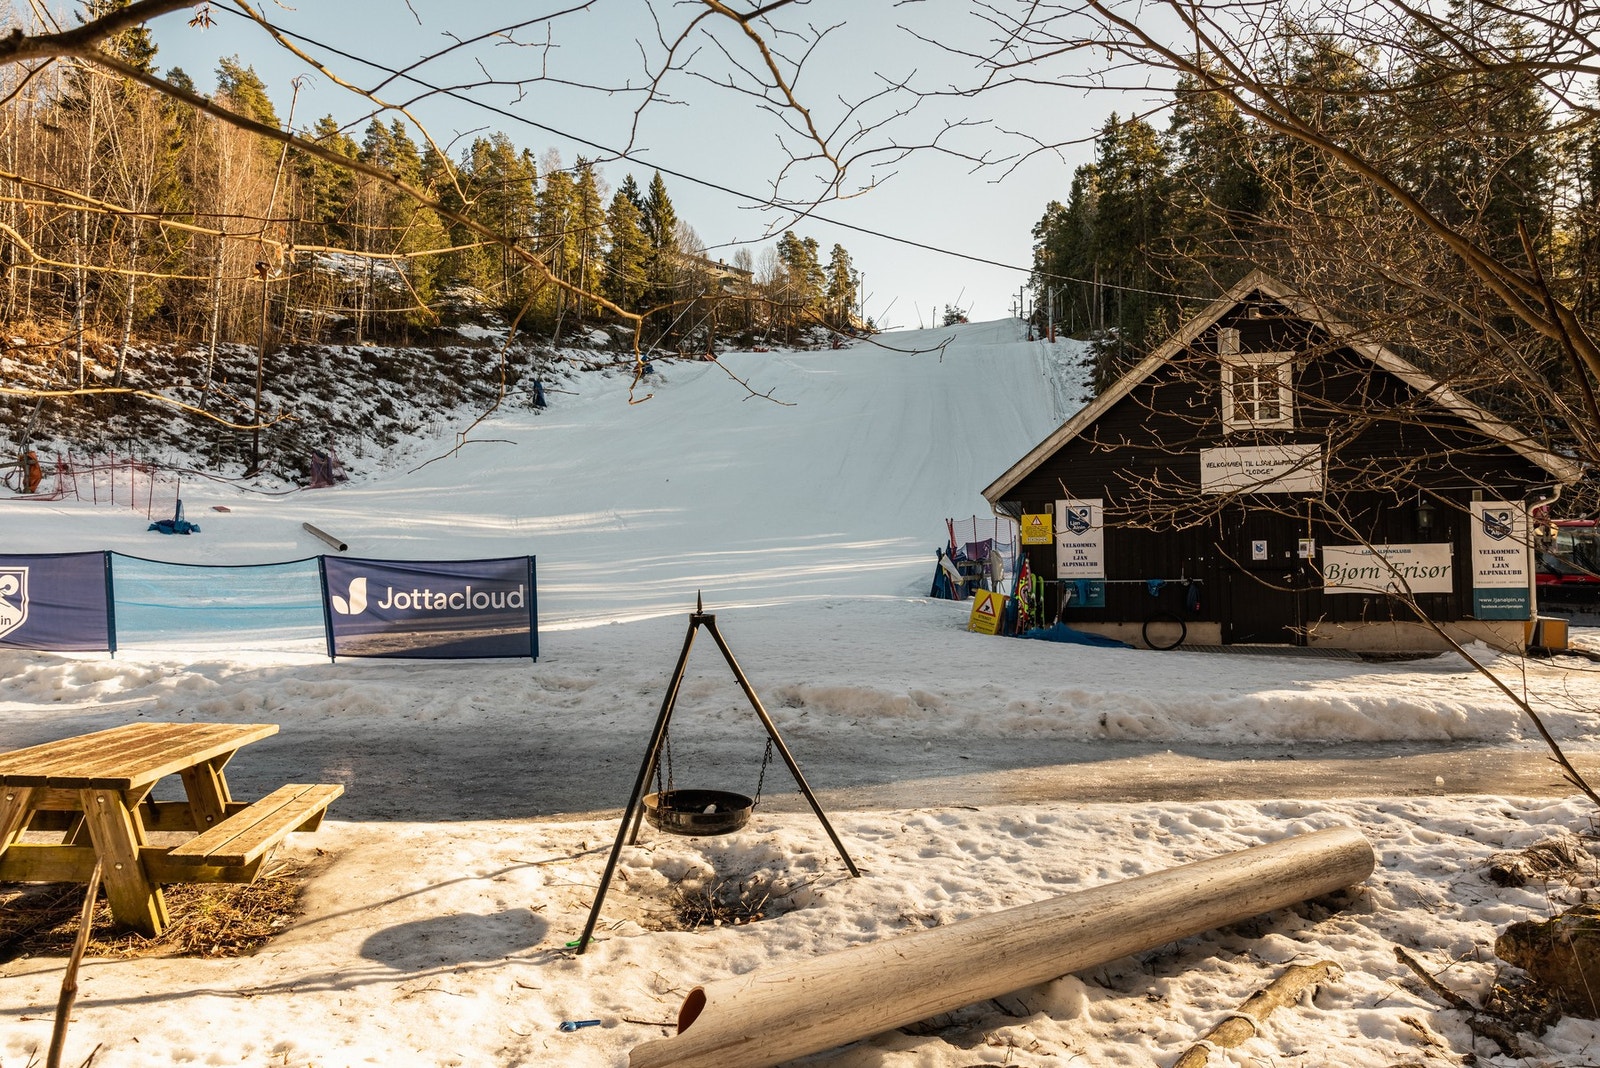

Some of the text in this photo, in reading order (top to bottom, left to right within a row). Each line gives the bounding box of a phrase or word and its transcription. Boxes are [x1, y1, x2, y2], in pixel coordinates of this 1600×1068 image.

[1206, 460, 1242, 468] VELKOMMEN
[1323, 562, 1380, 586] Bjørn
[377, 584, 525, 610] Jottacloud
